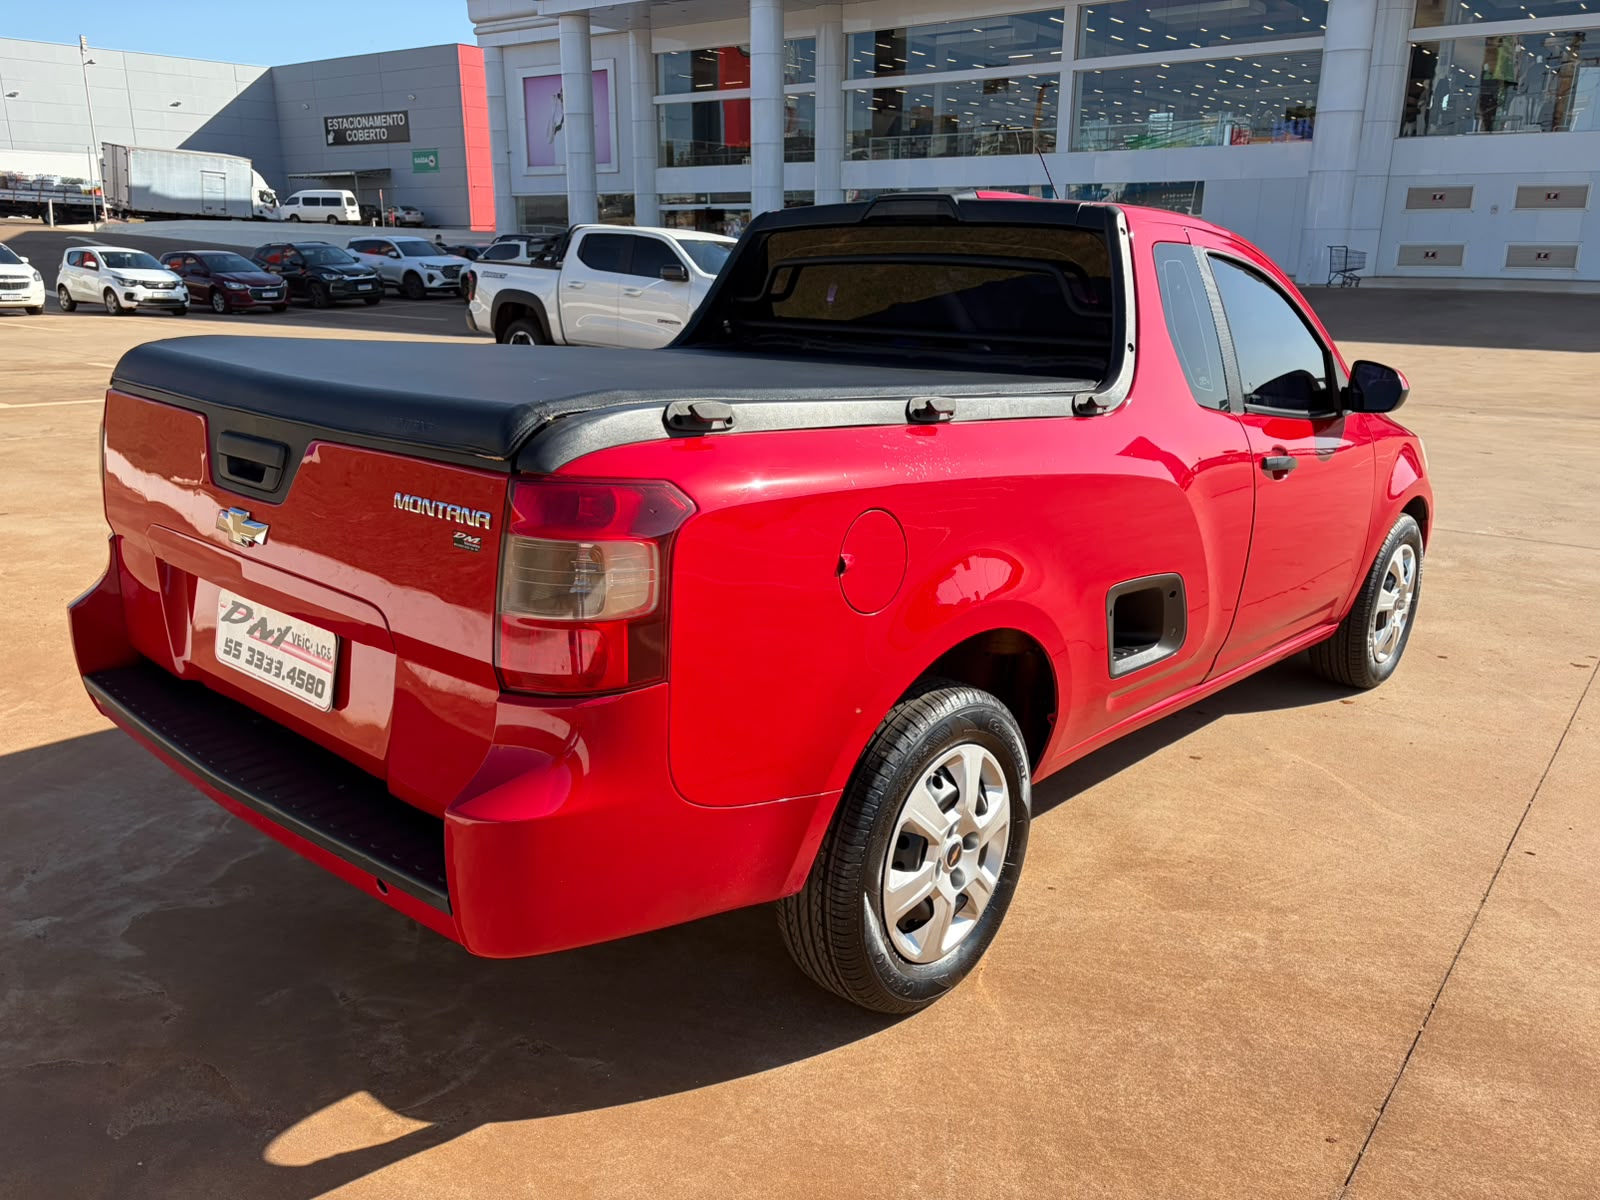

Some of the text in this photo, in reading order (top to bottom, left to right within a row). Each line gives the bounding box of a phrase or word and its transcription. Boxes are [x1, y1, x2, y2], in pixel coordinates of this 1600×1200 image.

[327, 113, 405, 130] ESTACIONAMENTO
[346, 128, 388, 142] COBERTO
[393, 491, 491, 530] MONTANA
[223, 636, 326, 699] 55 3333.4580
